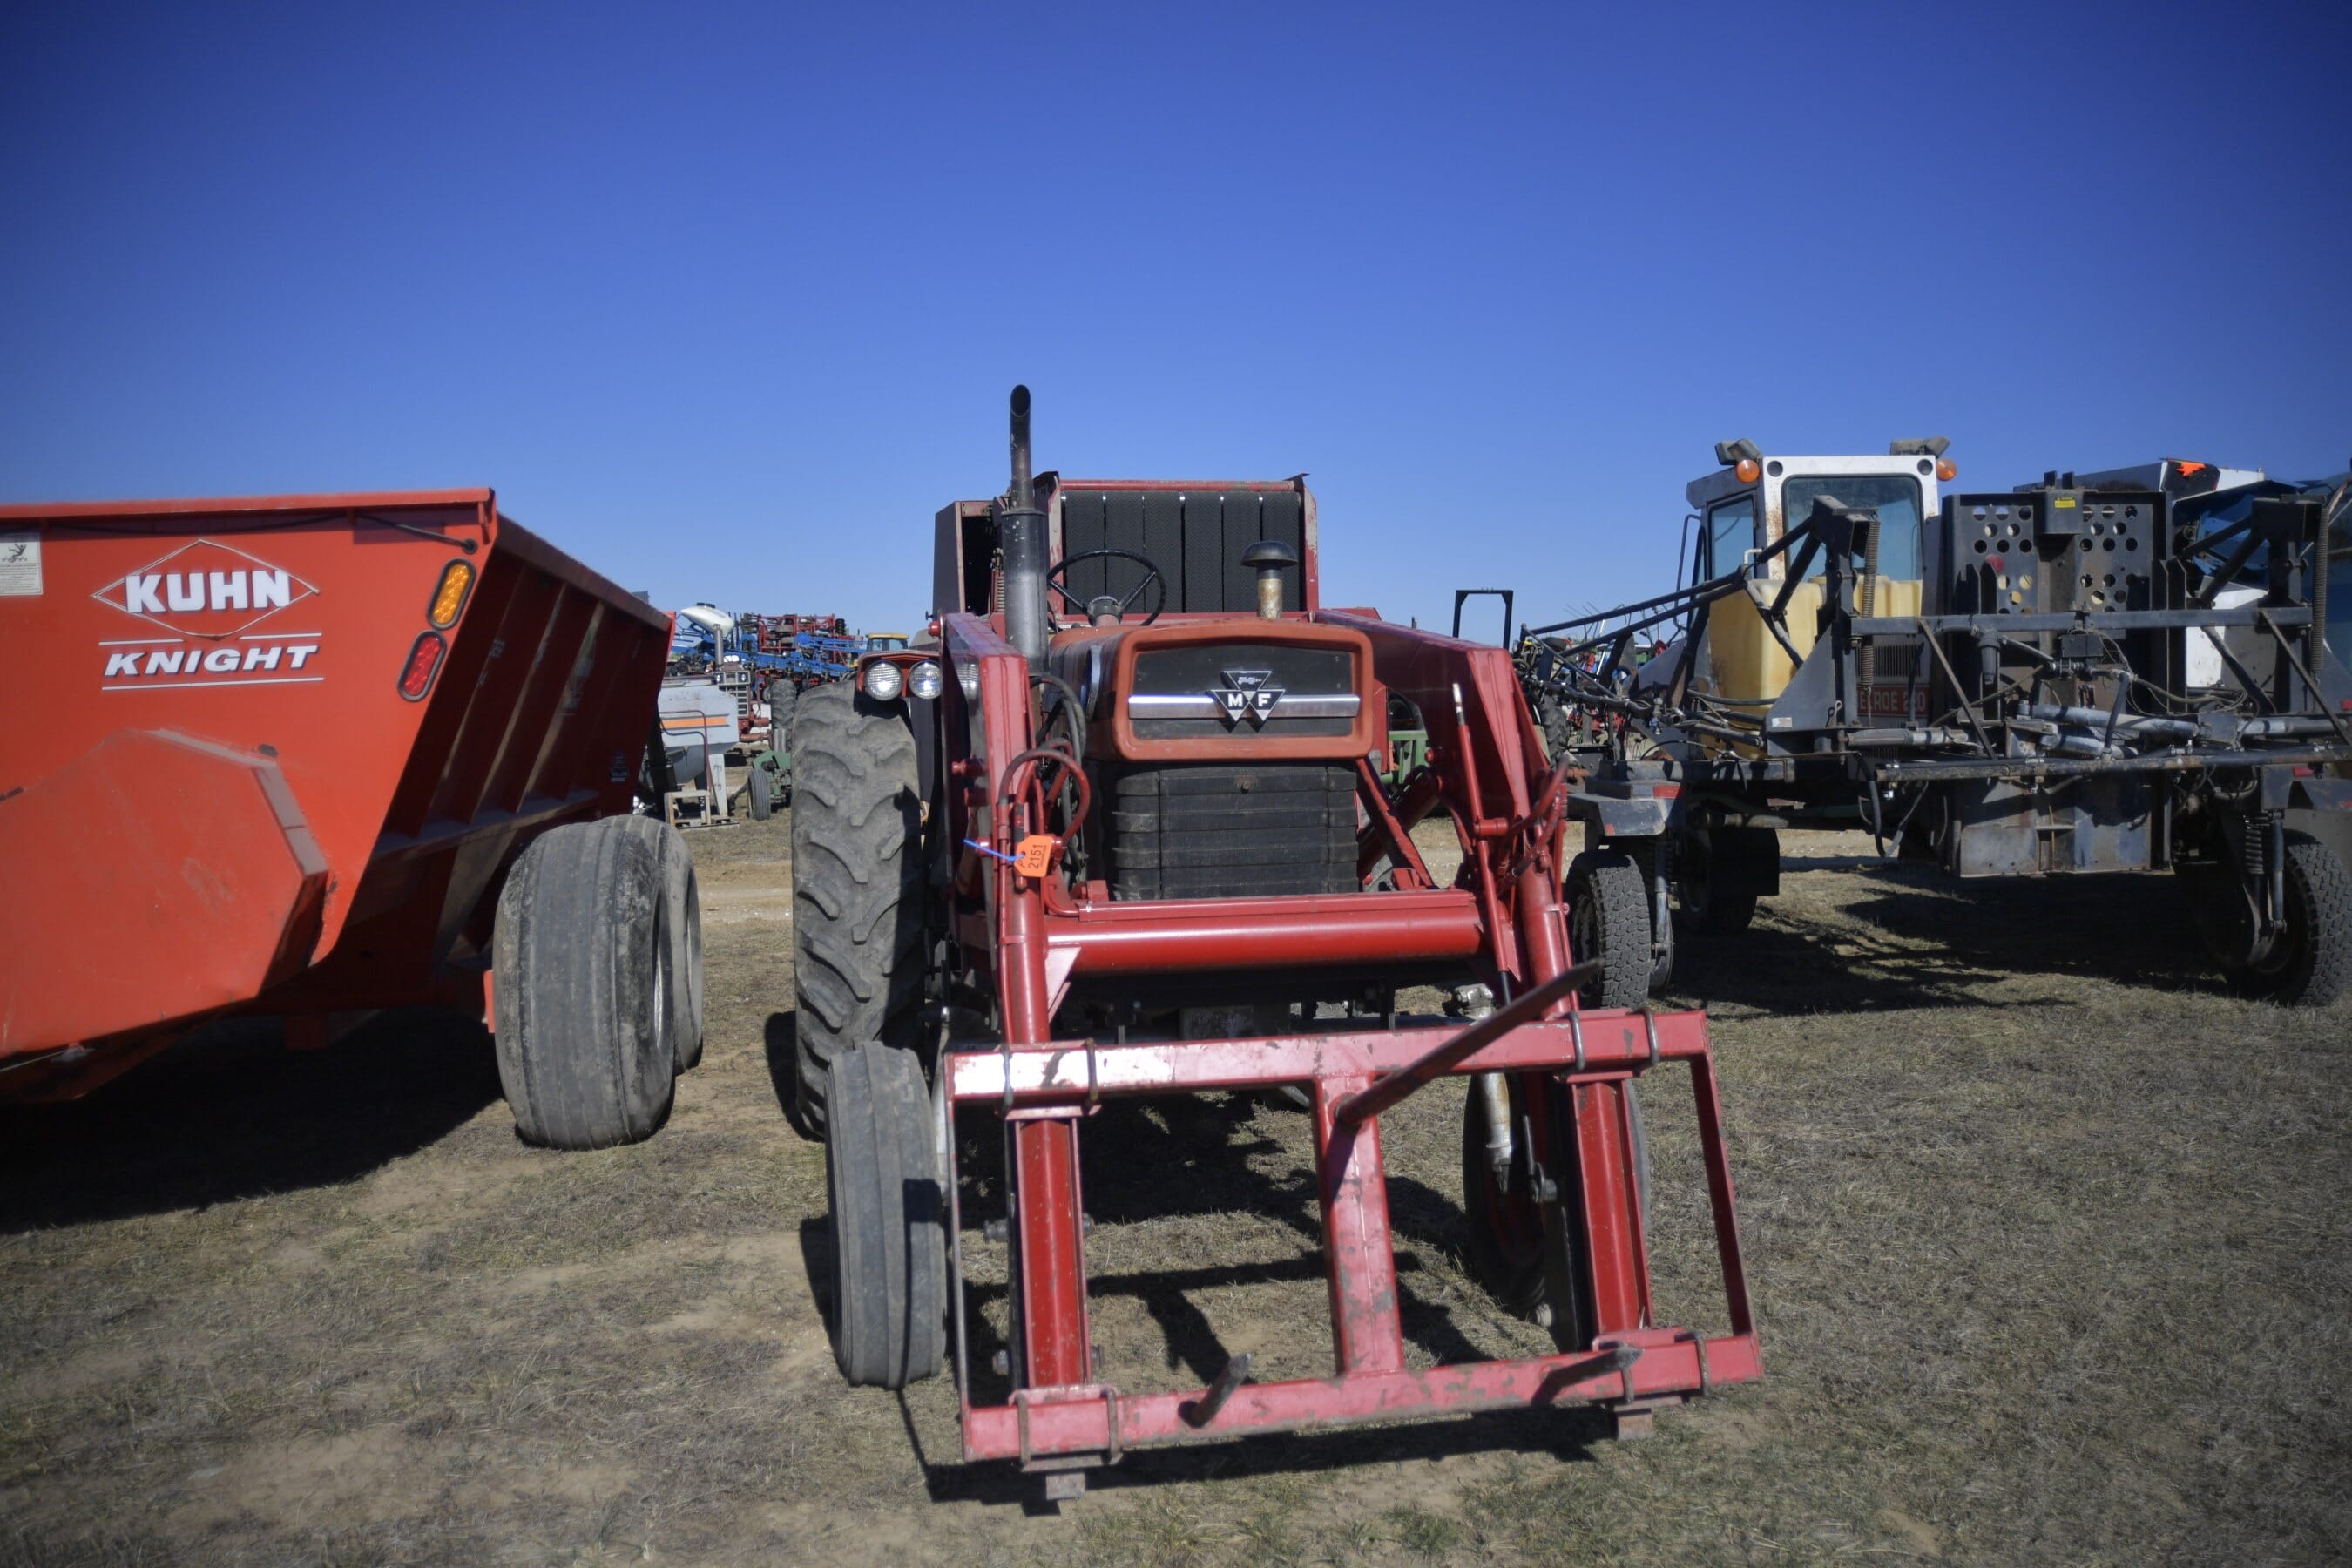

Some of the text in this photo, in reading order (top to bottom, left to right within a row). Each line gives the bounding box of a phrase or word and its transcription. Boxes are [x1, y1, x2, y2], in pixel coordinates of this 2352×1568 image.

[125, 570, 291, 613] KUHN
[104, 645, 319, 676] KNIGHT
[1227, 693, 1272, 707] M F
[1859, 690, 1897, 712] EROE
[1027, 844, 1044, 869] 2151
